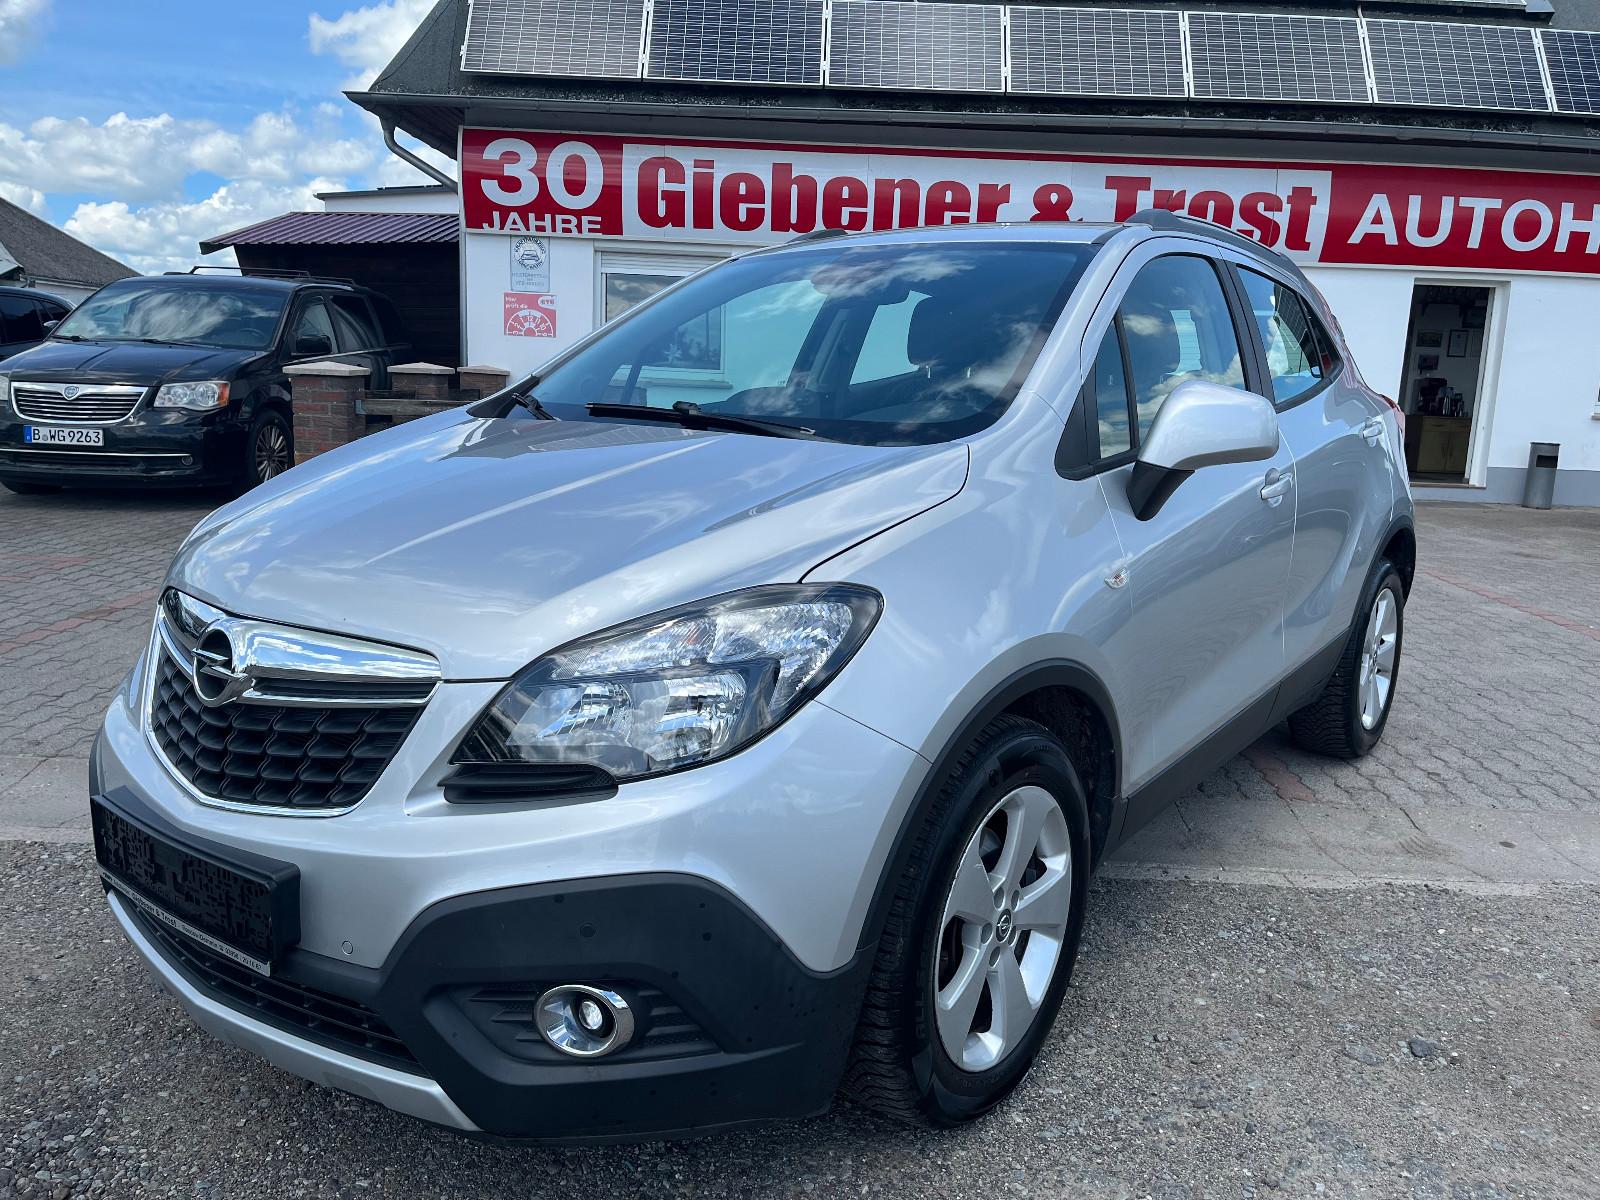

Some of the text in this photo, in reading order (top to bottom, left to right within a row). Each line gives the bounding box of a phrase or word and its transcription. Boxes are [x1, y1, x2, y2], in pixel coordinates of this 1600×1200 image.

[480, 138, 604, 210] 30
[637, 156, 1012, 233] Giebener
[1029, 183, 1084, 222] &
[482, 211, 604, 236] JAHRE
[1346, 193, 1600, 255] AUTOH
[33, 428, 101, 444] B WG 9263
